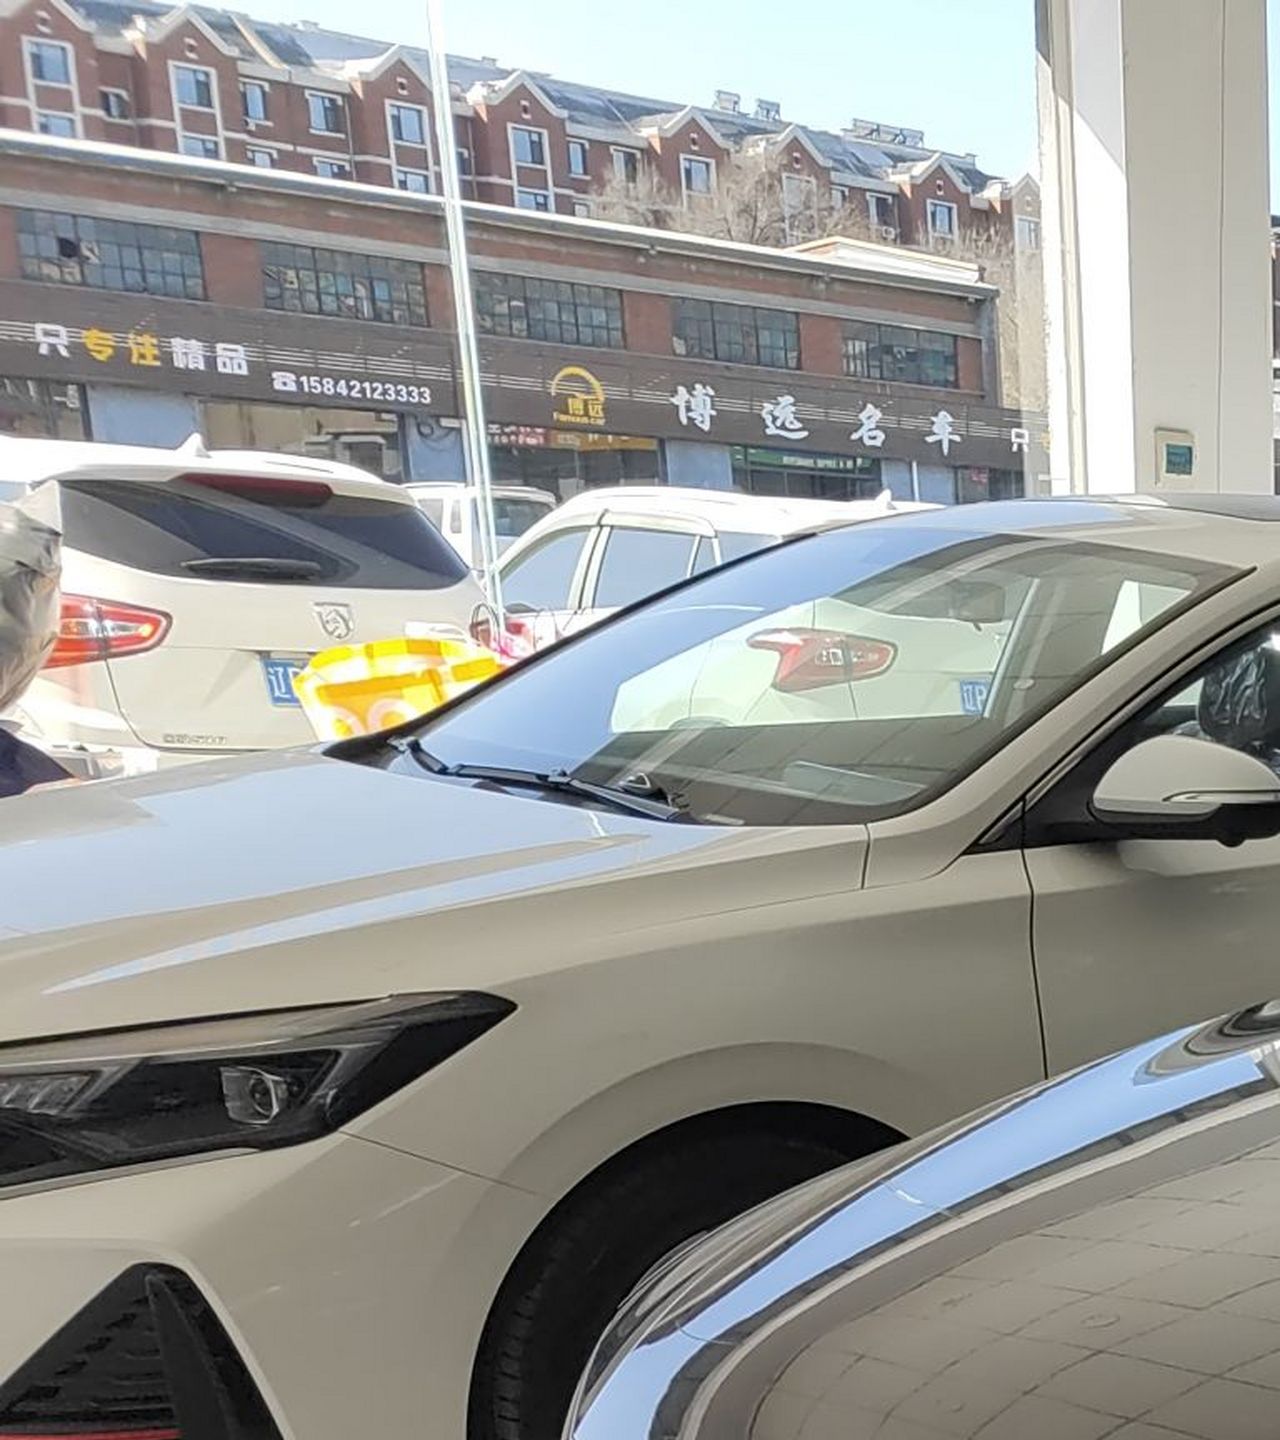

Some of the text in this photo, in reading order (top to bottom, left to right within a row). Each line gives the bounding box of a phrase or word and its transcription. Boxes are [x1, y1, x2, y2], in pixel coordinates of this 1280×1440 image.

[34, 322, 249, 376] 只专注精品
[299, 375, 431, 404] 15842123333
[670, 384, 962, 456] 博远名车
